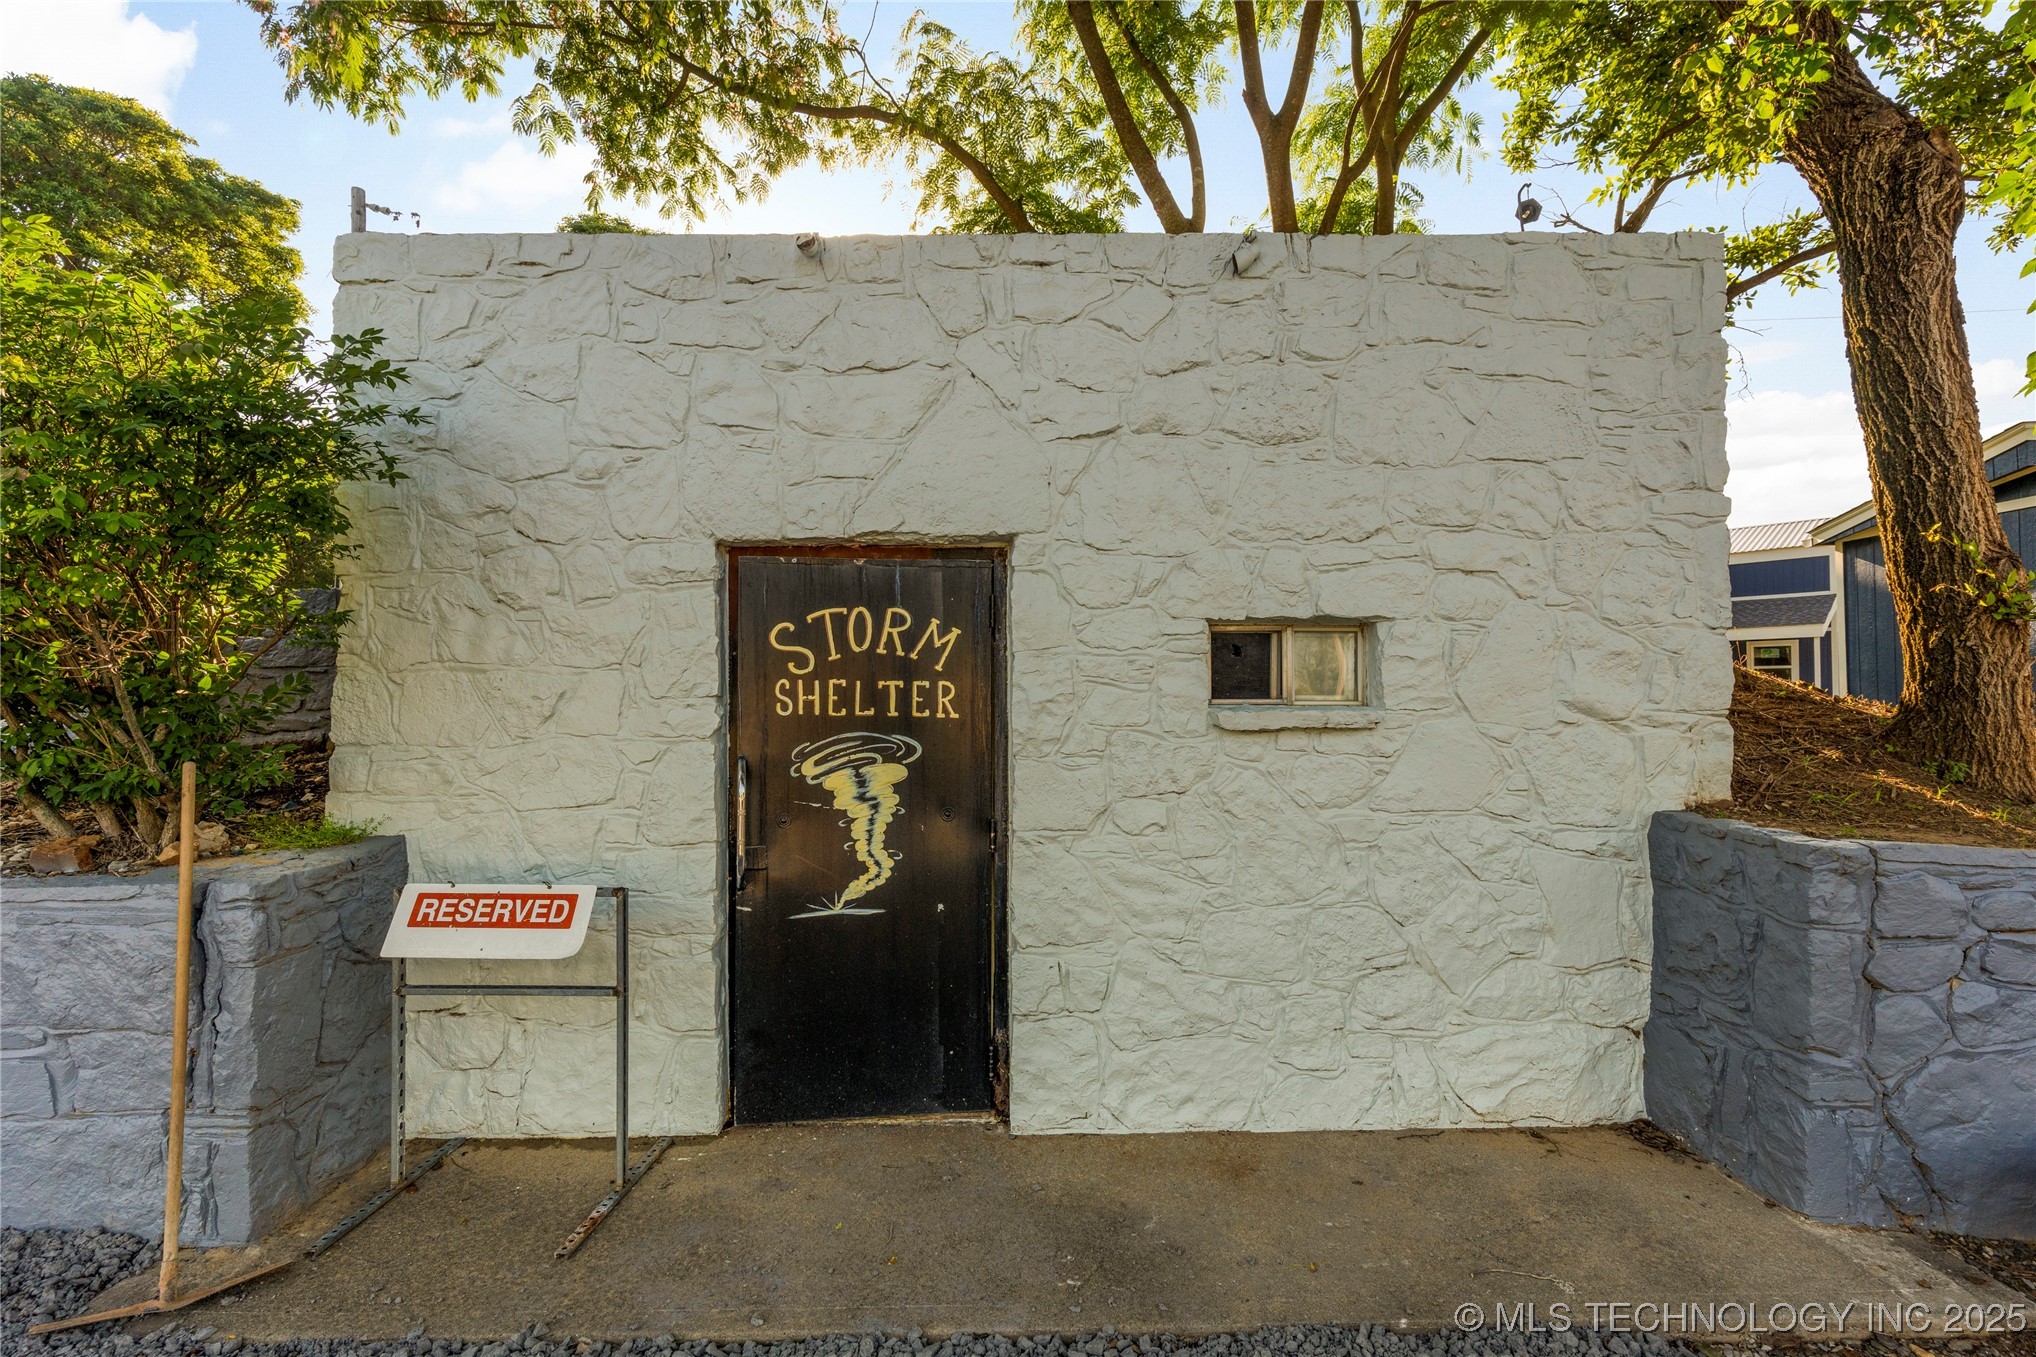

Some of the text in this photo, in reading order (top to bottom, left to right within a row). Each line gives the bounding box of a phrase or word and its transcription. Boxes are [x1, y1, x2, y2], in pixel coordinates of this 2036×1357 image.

[768, 606, 961, 674] STORM
[774, 678, 960, 719] SHELTER
[416, 898, 570, 924] RESERVED
